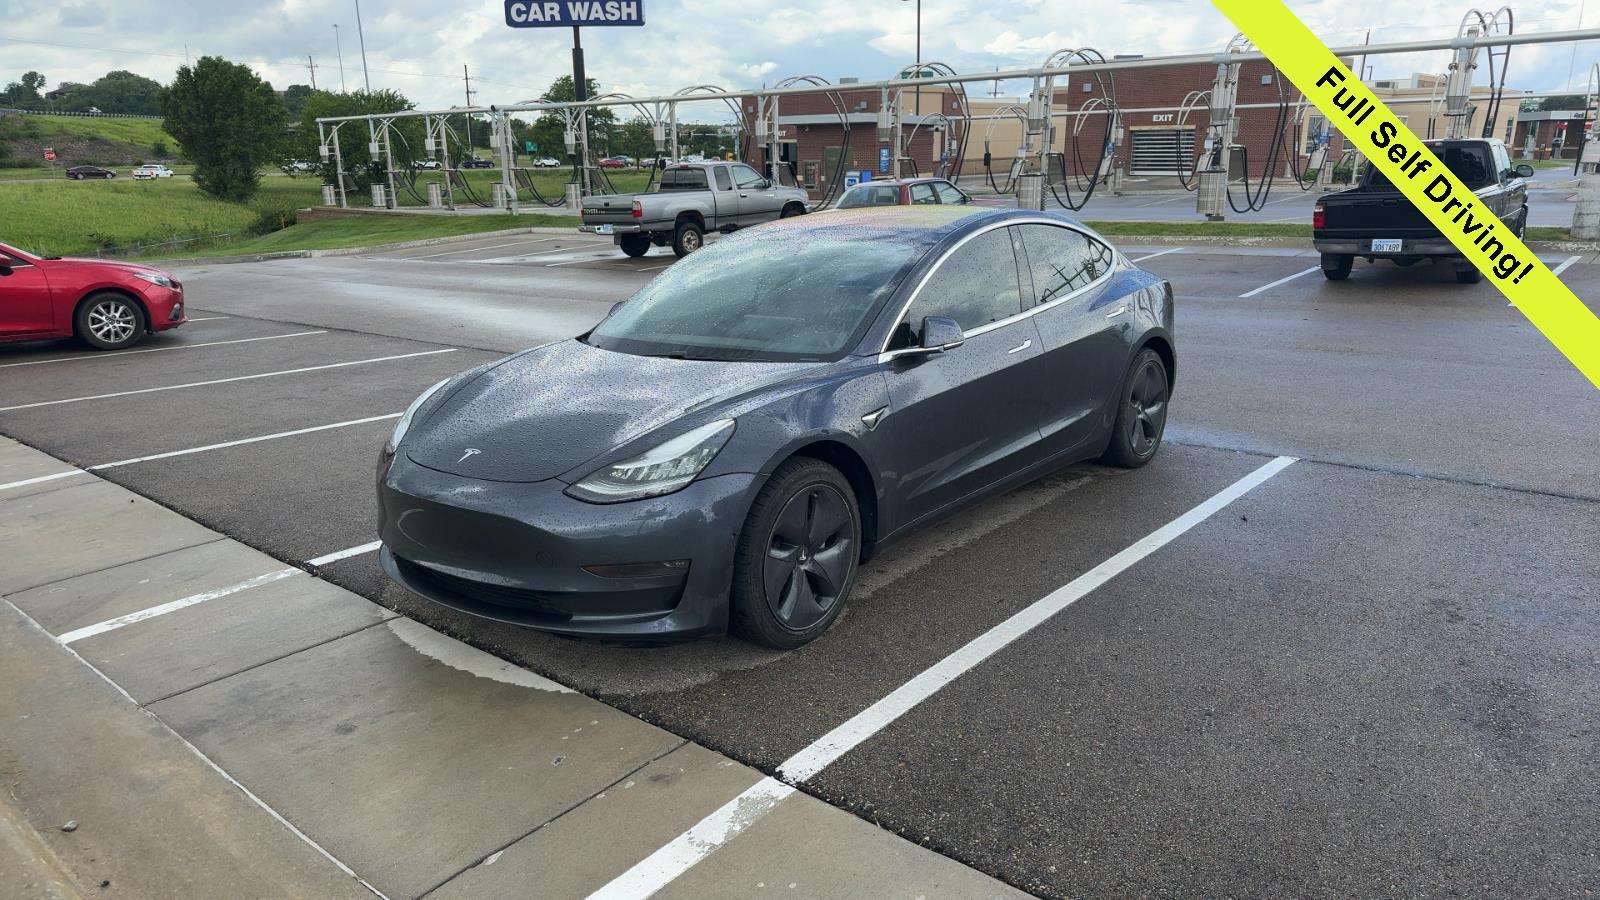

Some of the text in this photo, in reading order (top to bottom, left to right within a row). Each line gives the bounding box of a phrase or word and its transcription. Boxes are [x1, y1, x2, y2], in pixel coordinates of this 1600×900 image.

[510, 1, 637, 22] CAR WASH
[1152, 114, 1174, 122] EXIT
